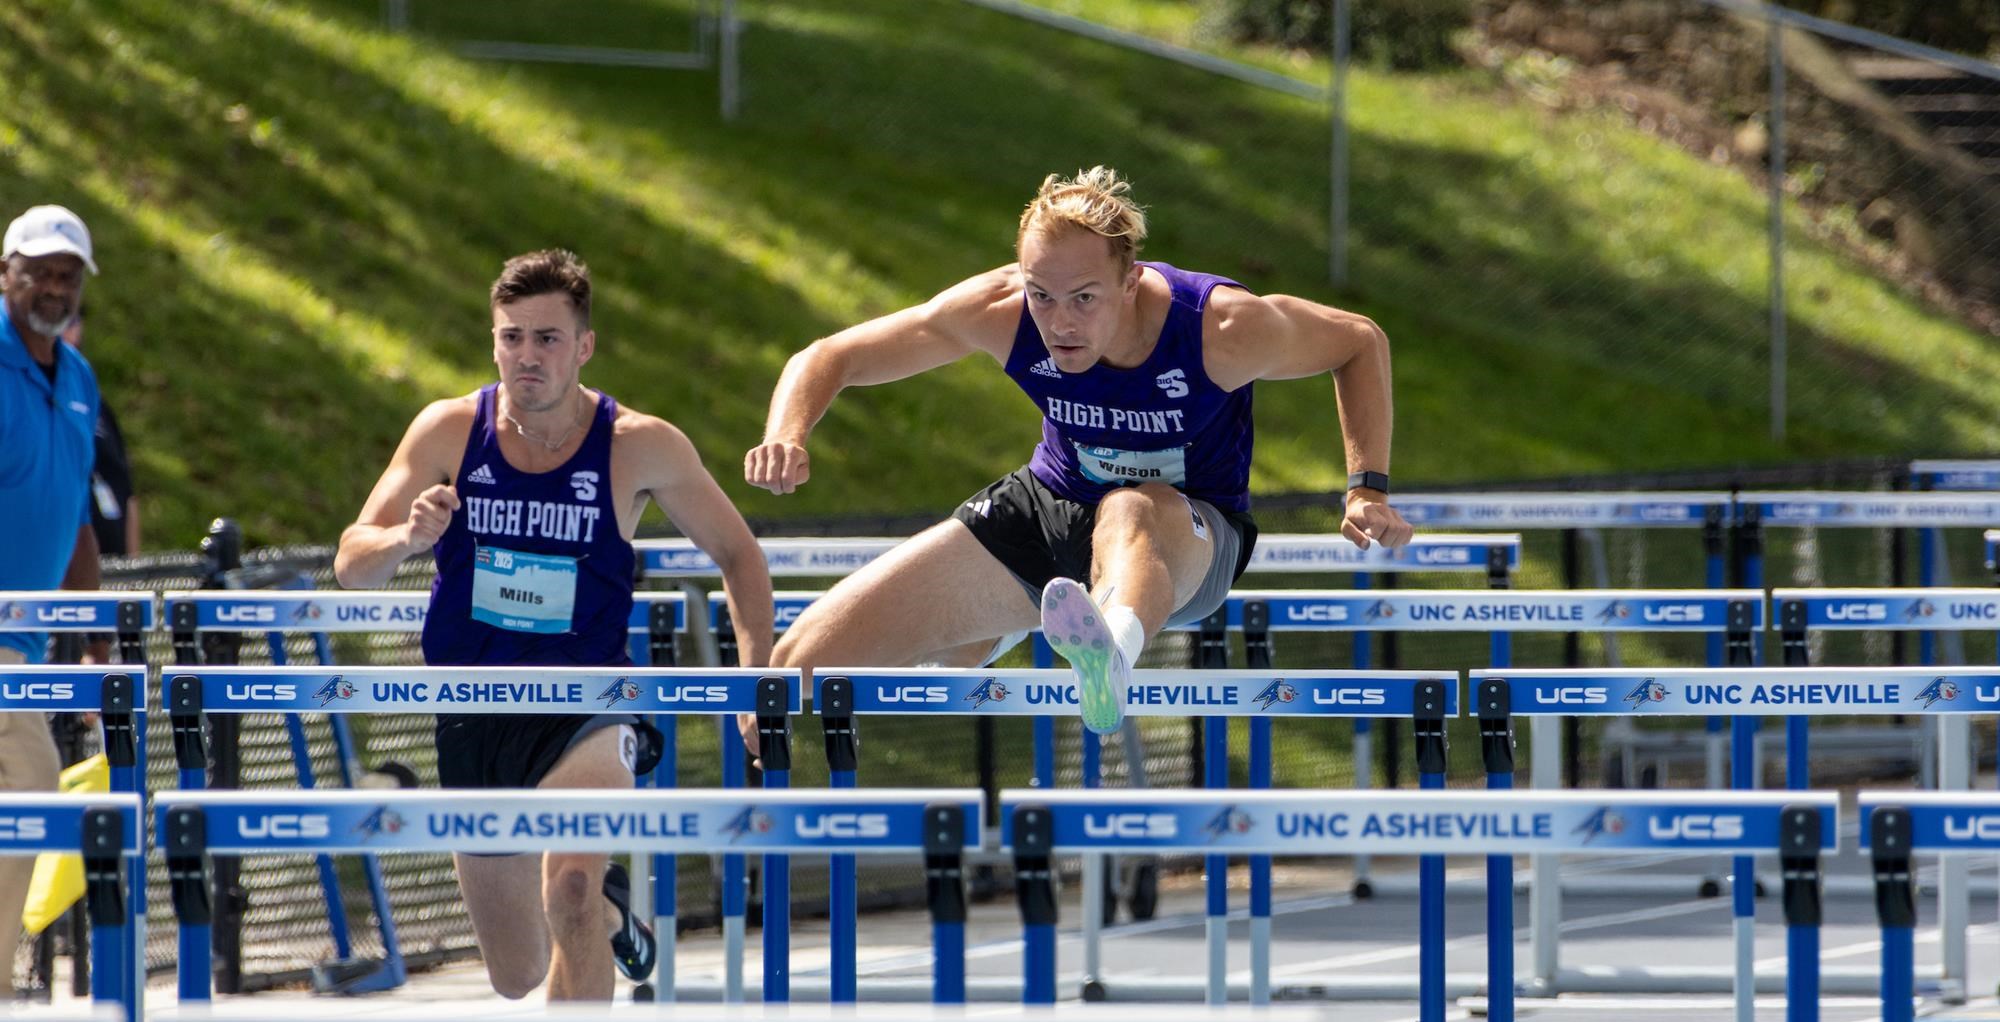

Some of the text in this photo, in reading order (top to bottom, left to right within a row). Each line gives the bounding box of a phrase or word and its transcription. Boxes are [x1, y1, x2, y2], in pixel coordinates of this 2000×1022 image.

[1030, 366, 1062, 379] adidas
[1156, 368, 1189, 398] S
[1047, 396, 1184, 433] HIGH POINT
[1099, 460, 1161, 478] Wilson
[467, 475, 496, 485] adidas
[466, 496, 600, 543] HIGH POINT
[1416, 547, 1470, 563] UCS
[500, 586, 544, 605] Mills
[37, 606, 97, 622] UCS
[215, 605, 275, 622] UCS
[336, 605, 381, 621] UNC
[1287, 604, 1704, 621] UCS UNC ASHEVILLE UCS
[1826, 603, 1997, 620] UCS UNC
[3, 683, 74, 700] UCS
[226, 683, 729, 702] UCS UNC ASHEVILLE UCS
[877, 685, 1385, 705] UCS UNC HEVILLE UCS
[1536, 684, 1900, 705] UCS UNC ASHEVILLE
[238, 813, 889, 838] UCS UNC ASHEVILLE UCS
[1084, 813, 1743, 839] UCS UNC ASHEVILLE UCS
[1944, 816, 2000, 839] UC
